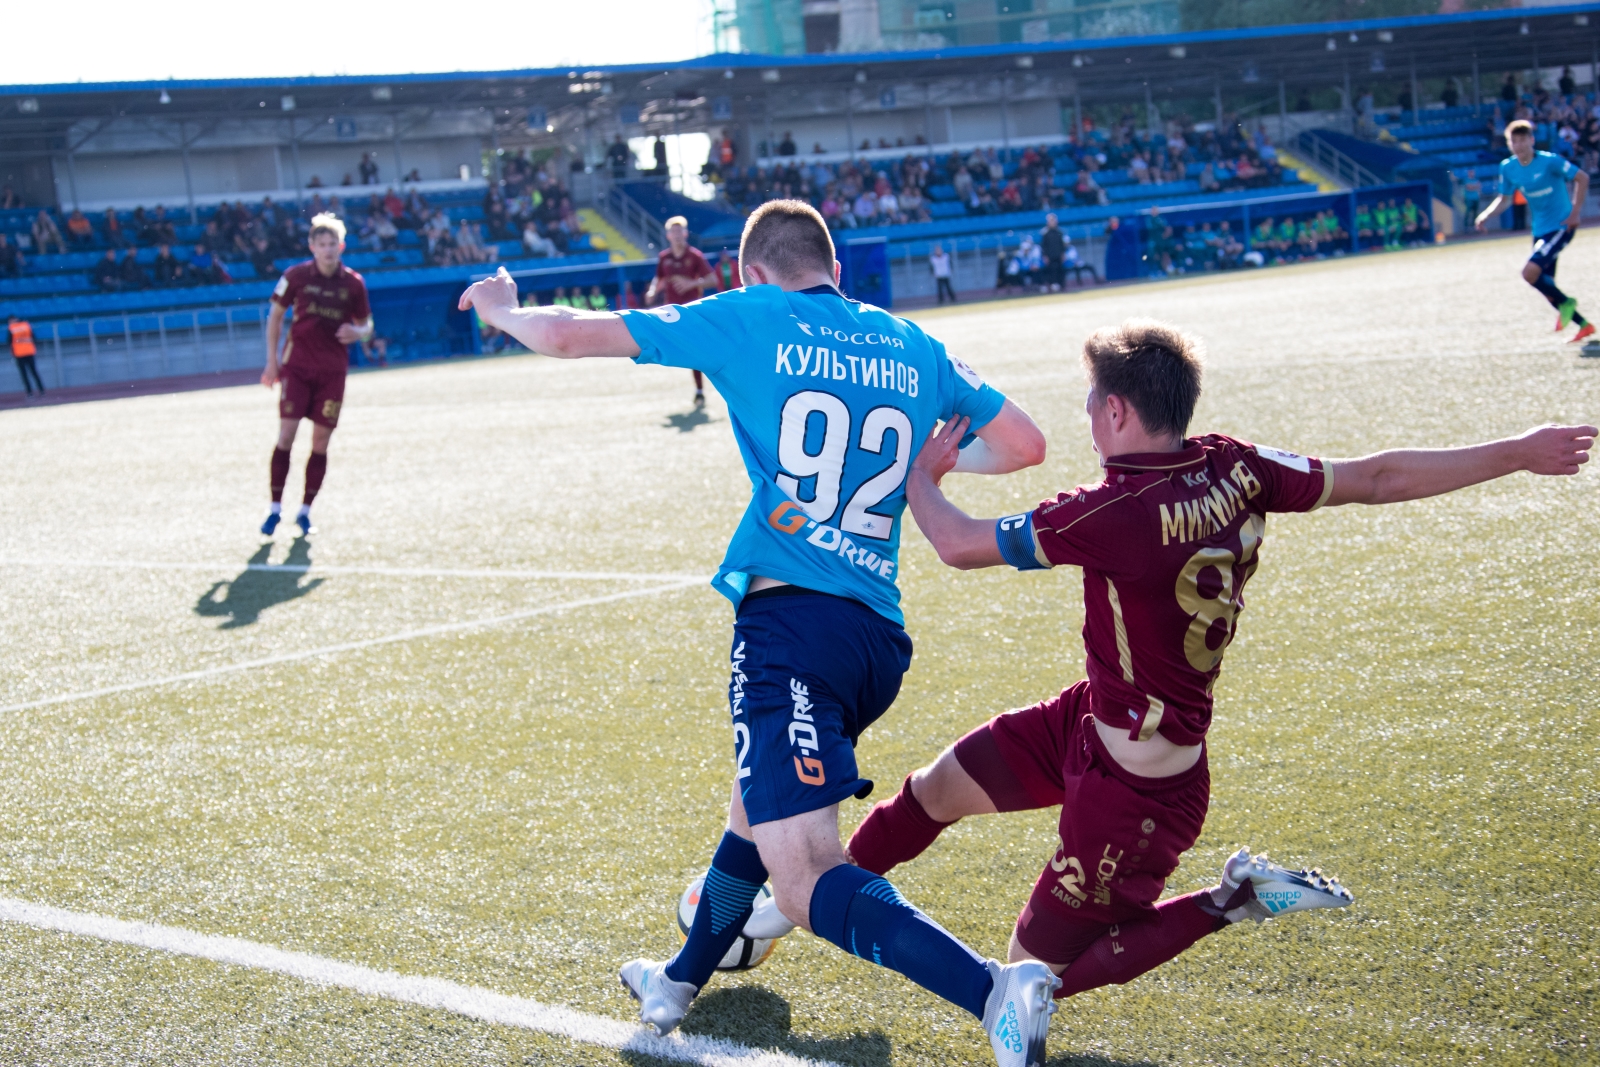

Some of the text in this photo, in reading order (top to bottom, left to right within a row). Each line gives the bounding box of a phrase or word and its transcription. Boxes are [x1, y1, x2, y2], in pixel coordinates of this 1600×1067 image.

[820, 326, 905, 350] РОССИЯ
[775, 343, 919, 398] КУЛЬТИНОВ
[776, 389, 913, 541] 92
[1050, 886, 1081, 909] JAKO
[1258, 890, 1302, 901] adidas
[1006, 1001, 1023, 1054] adidas
